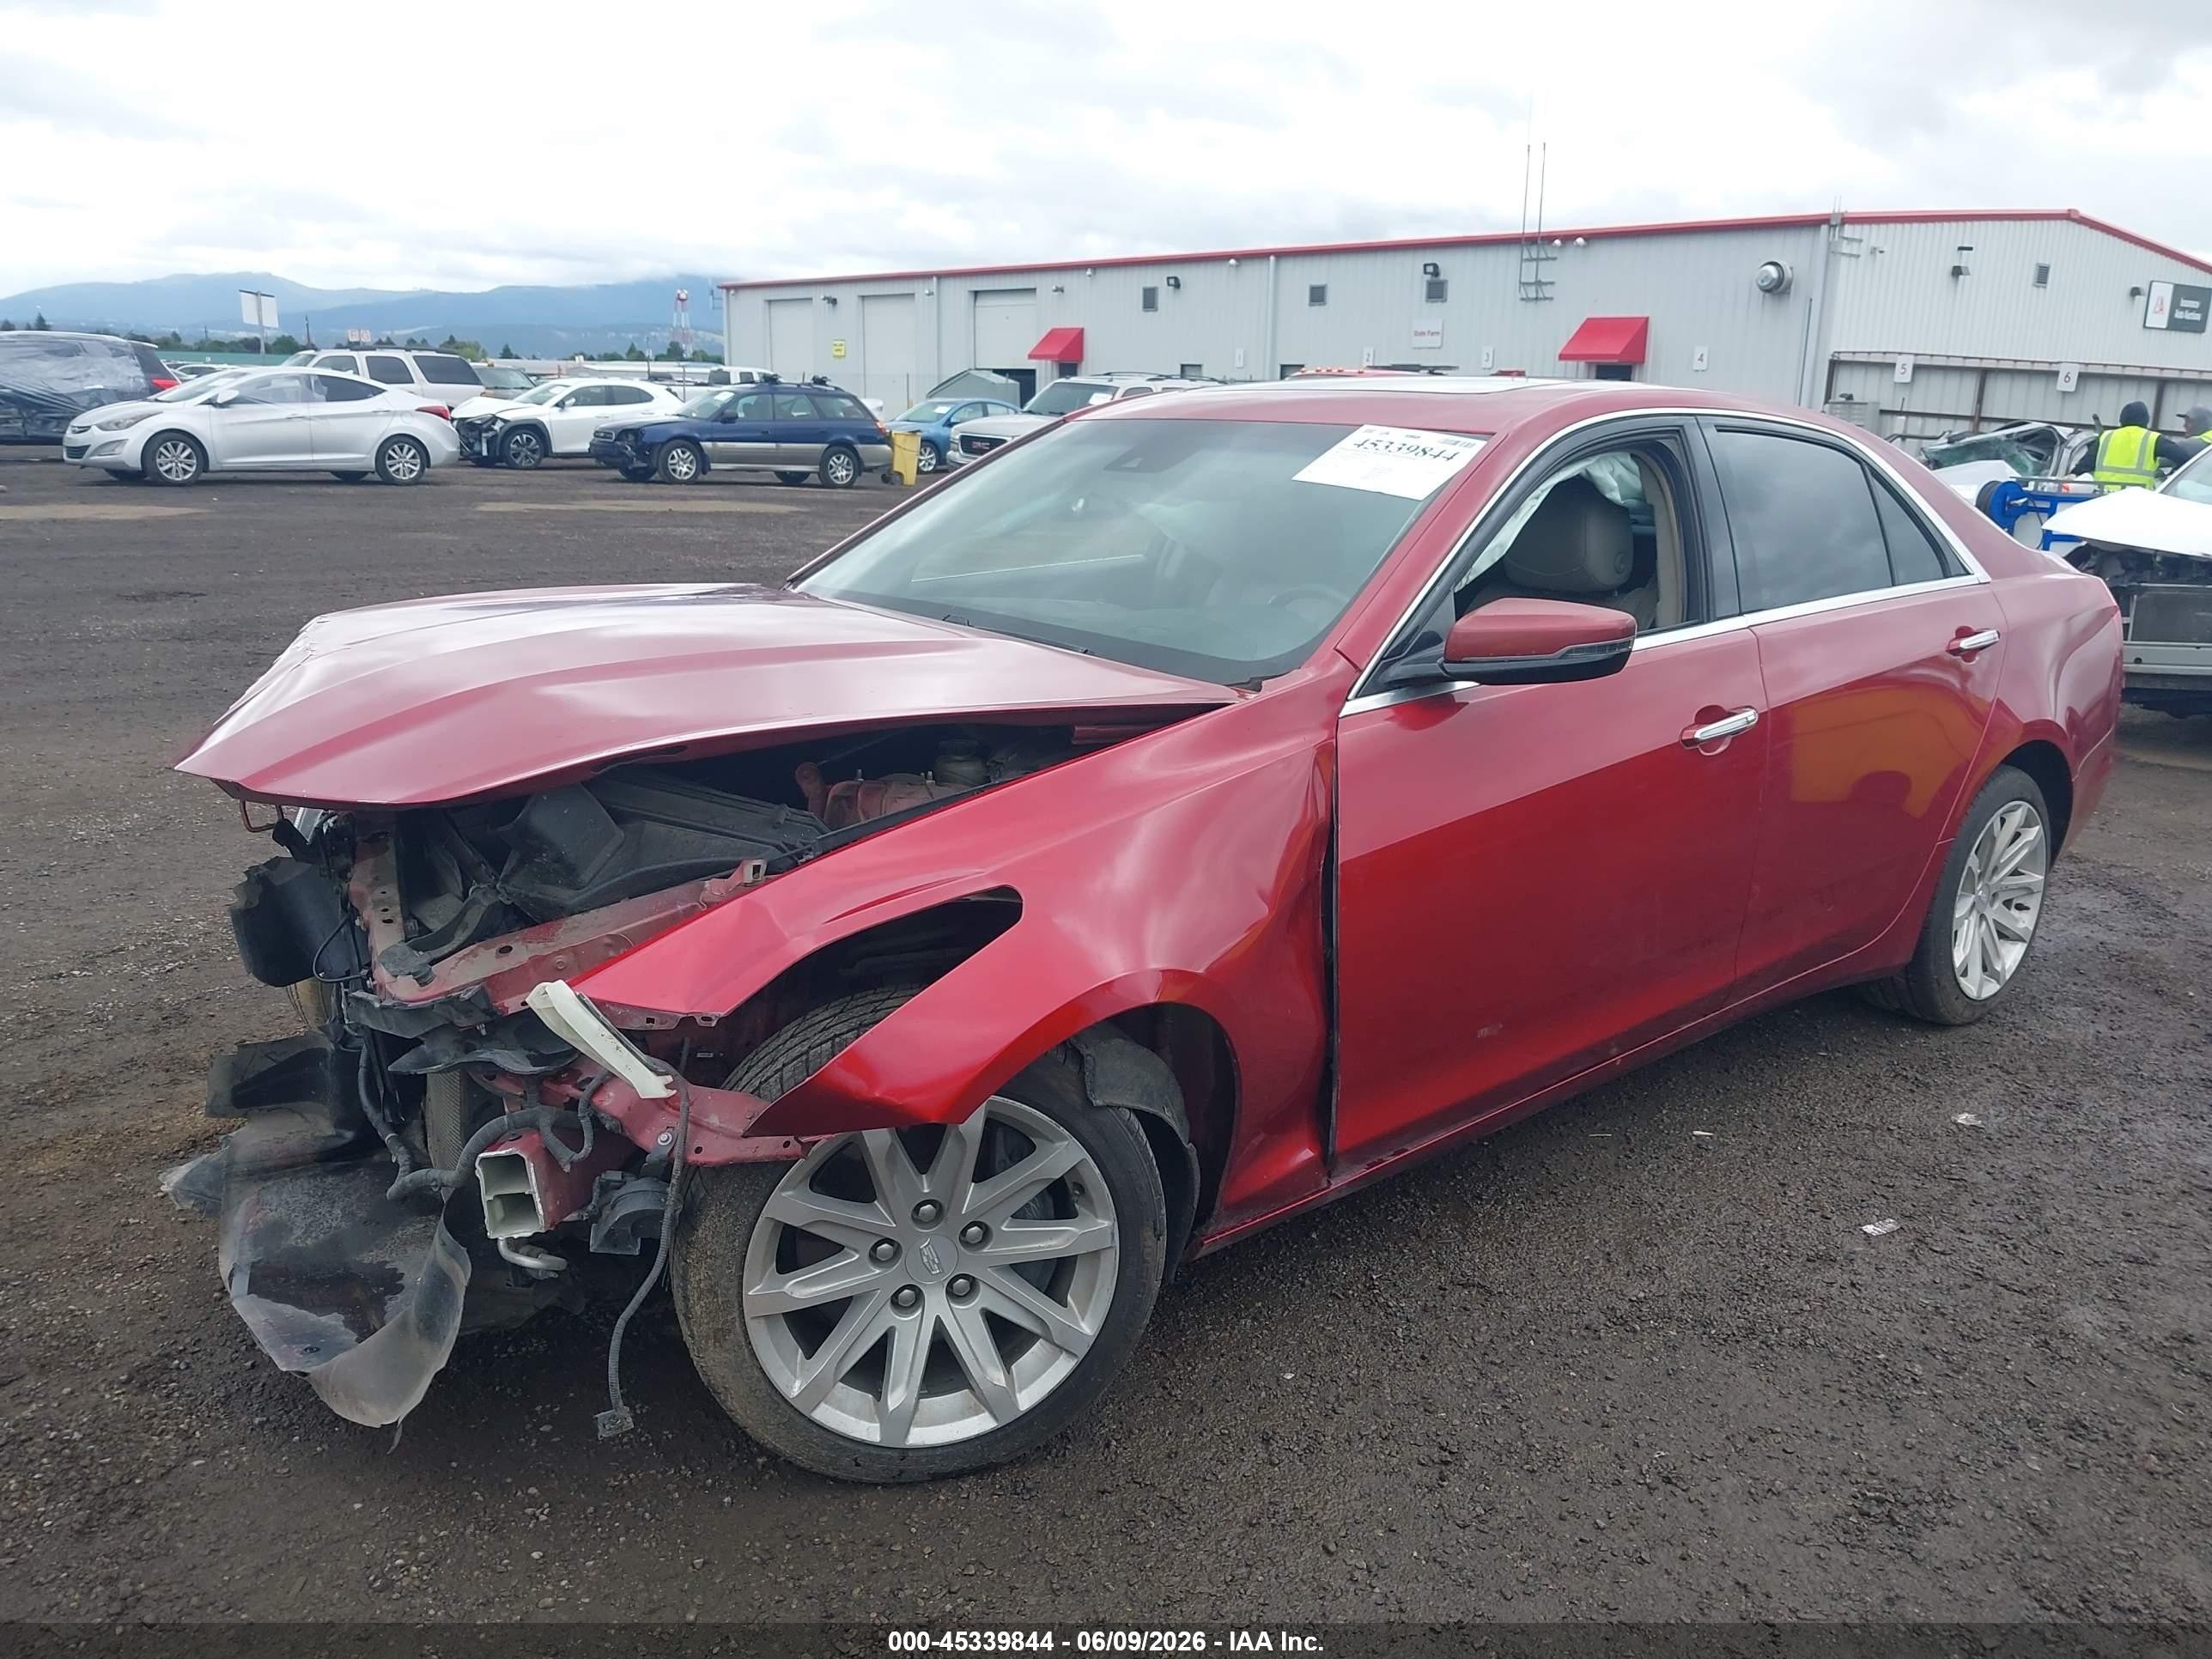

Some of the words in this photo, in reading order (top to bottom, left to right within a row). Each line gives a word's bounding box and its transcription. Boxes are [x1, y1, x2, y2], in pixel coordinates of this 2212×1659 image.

[1697, 352, 1704, 363] 4
[1900, 364, 1907, 375] 5
[2063, 371, 2071, 383] 6
[1353, 439, 1460, 461] 45339844
